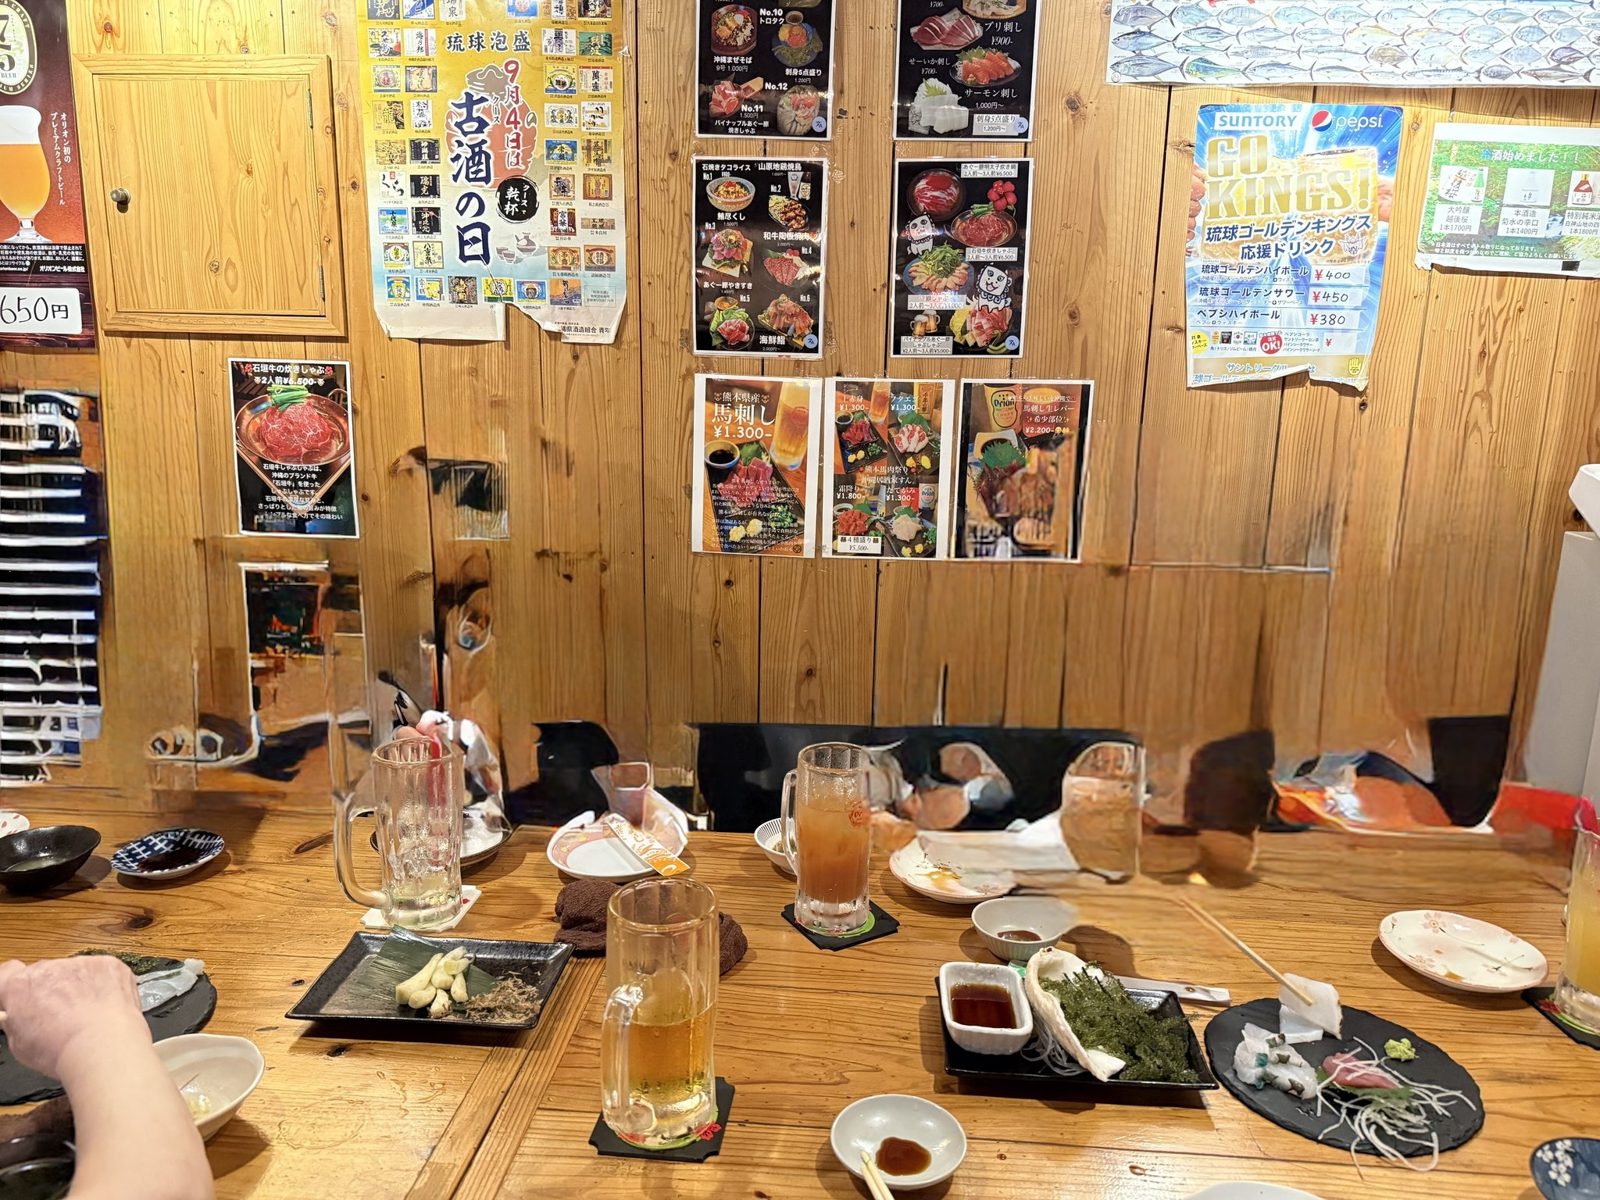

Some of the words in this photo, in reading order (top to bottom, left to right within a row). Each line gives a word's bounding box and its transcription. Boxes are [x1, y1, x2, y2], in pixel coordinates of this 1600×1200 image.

[760, 8, 783, 16] No.10
[760, 17, 785, 25] トロタク
[984, 21, 1022, 33] ブリ刺し
[446, 32, 532, 52] 琉球泡盛
[713, 56, 753, 64] 沖縄まぜそば
[765, 83, 788, 91] No.12
[964, 88, 1018, 98] サーモン刺し
[741, 104, 764, 112] No.11
[1218, 115, 1298, 128] SUNTORY
[1335, 114, 1381, 131] pepsi
[60, 112, 72, 164] オリオン初の
[1207, 134, 1269, 178] GO
[702, 163, 751, 171] 石焼きタコライス
[450, 91, 492, 266] 古酒の日
[1206, 168, 1370, 220] KINGS!
[1205, 214, 1372, 242] 琉球ゴールデンキングス
[1240, 238, 1334, 261] 応援ドリンク
[1201, 264, 1309, 276] 琉球ゴールデンハイボール
[1199, 286, 1305, 298] 琉球ゴールデンサワー
[0, 294, 69, 325] 650円
[1196, 308, 1281, 320] ペプシハイボール
[1261, 342, 1280, 352] OK!
[253, 363, 325, 374] 石垣牛の炊きしゃぶ
[722, 391, 761, 403] 熊本県産
[711, 402, 776, 426] 馬刺し
